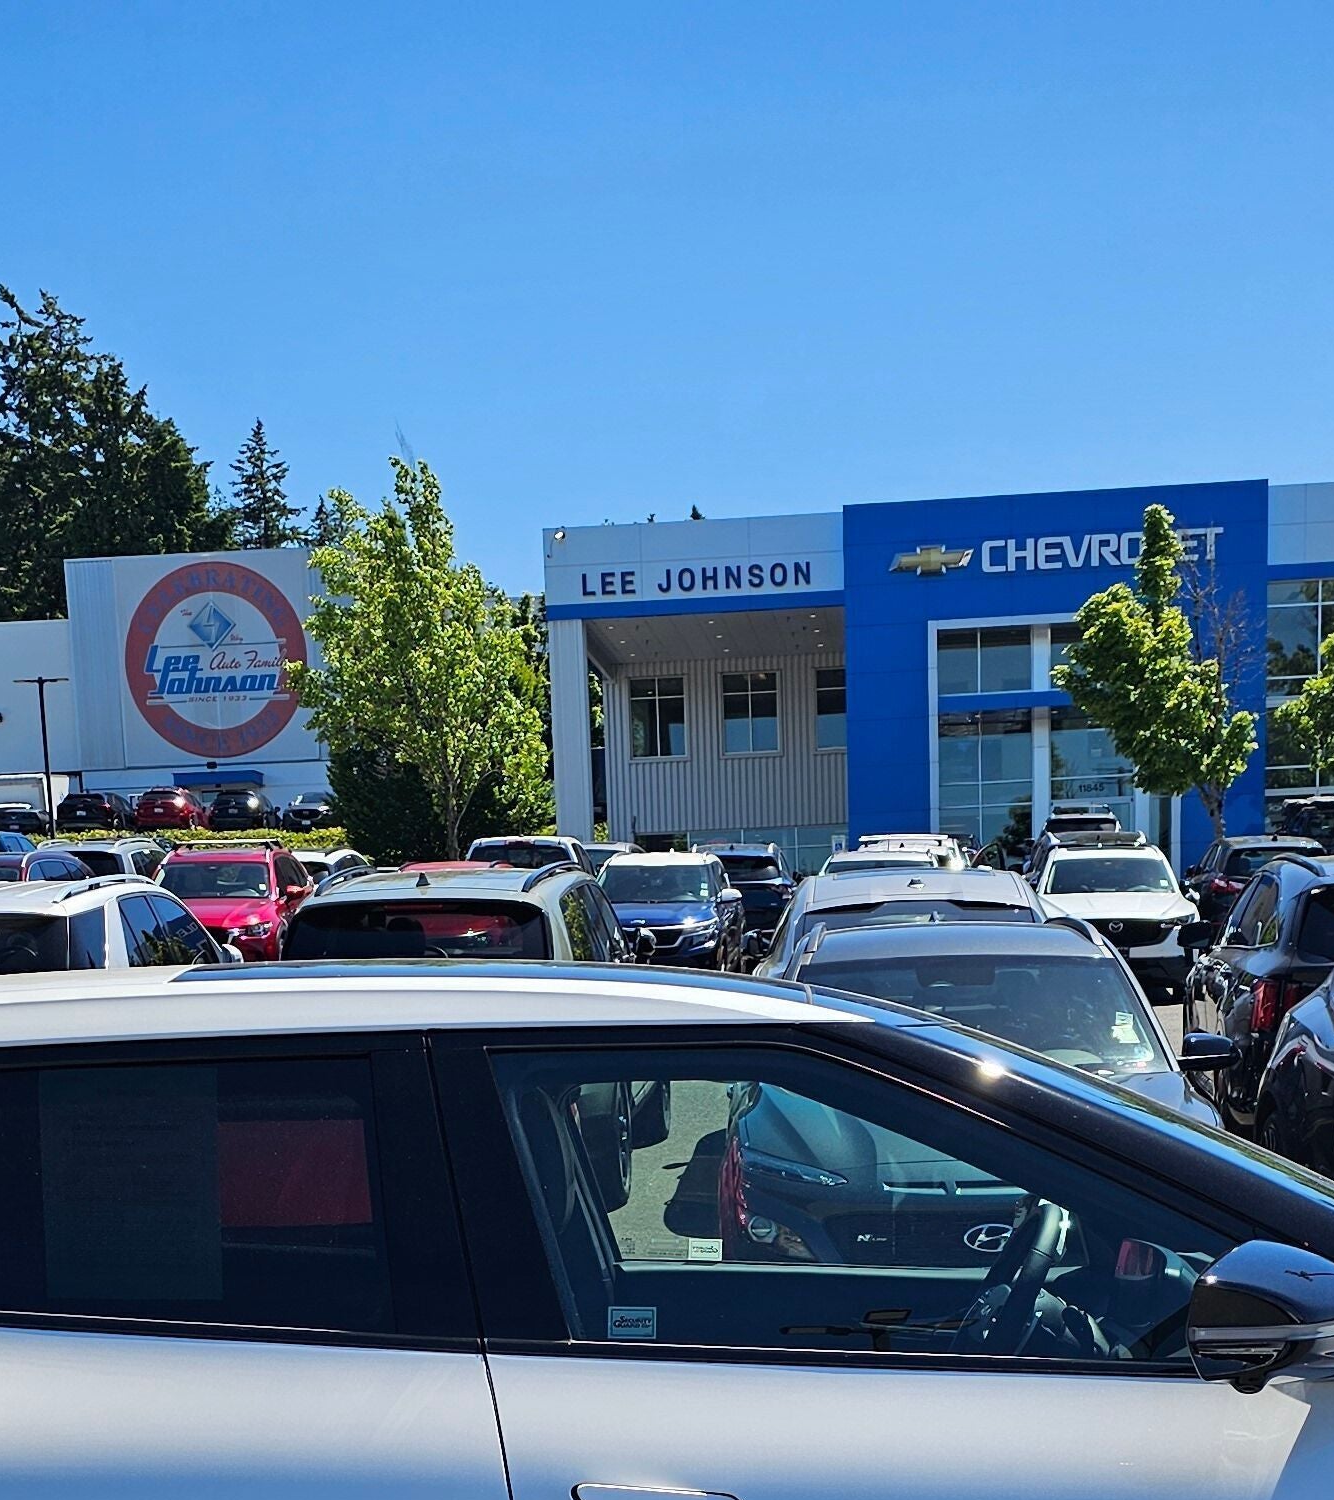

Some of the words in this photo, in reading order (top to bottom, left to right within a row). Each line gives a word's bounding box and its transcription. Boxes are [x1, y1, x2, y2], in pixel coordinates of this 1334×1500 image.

[981, 526, 1224, 573] CHEVROET
[581, 570, 636, 597] LEE
[657, 561, 812, 593] JOHNSON
[145, 645, 204, 674] Lee
[209, 650, 242, 671] Auto
[149, 665, 280, 696] Johnson
[1079, 783, 1105, 793] 11845
